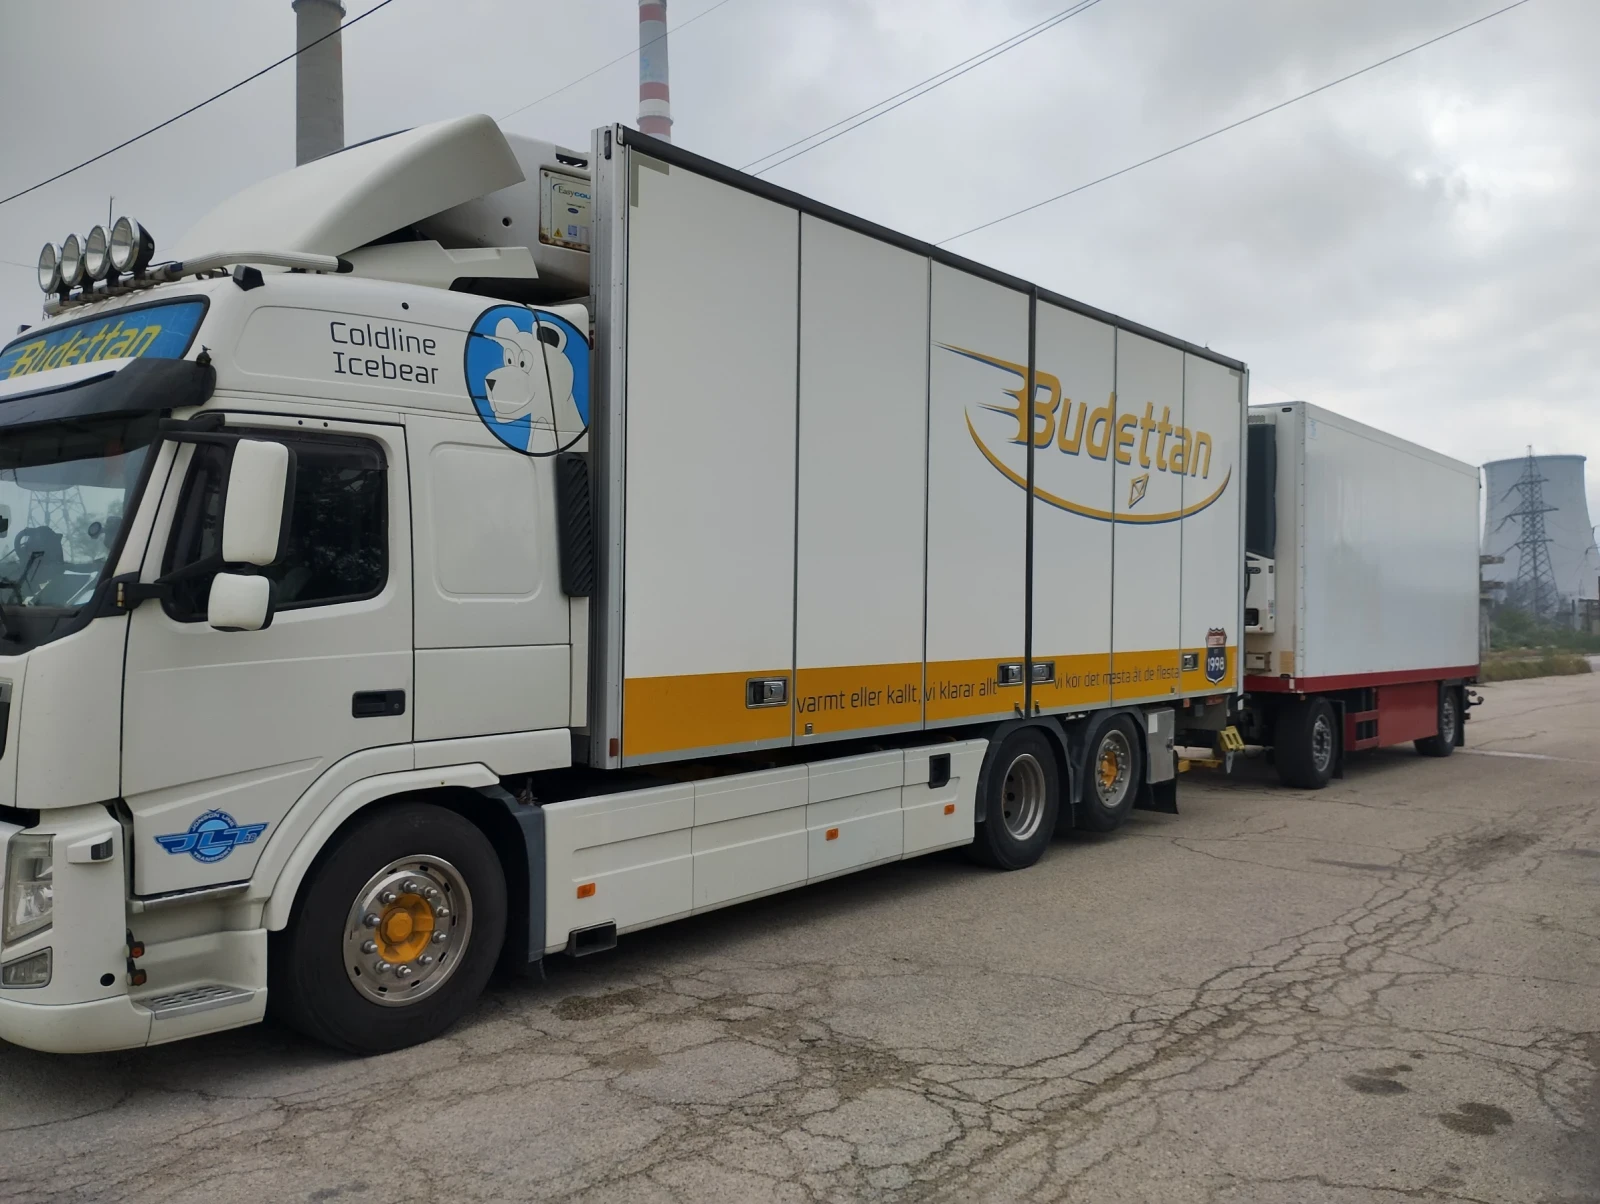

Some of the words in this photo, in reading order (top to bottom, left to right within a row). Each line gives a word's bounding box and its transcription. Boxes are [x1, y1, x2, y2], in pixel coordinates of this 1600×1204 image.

[8, 321, 162, 379] Budettan
[330, 321, 436, 356] Coldline
[333, 351, 439, 384] Icebear
[1005, 368, 1213, 479] Budettan
[1207, 656, 1225, 672] 1998
[797, 689, 845, 714] varmt
[850, 686, 882, 708] eller
[887, 683, 921, 705] kallt,
[924, 681, 936, 702] vi
[940, 680, 975, 700] klarar
[979, 677, 998, 697] allt
[1054, 673, 1063, 689] vi
[1084, 670, 1100, 687] det
[1103, 670, 1131, 685] mesta
[1144, 666, 1154, 681] de
[1157, 664, 1180, 681] flesta
[221, 814, 235, 827] LINE
[158, 824, 265, 853] JLT
